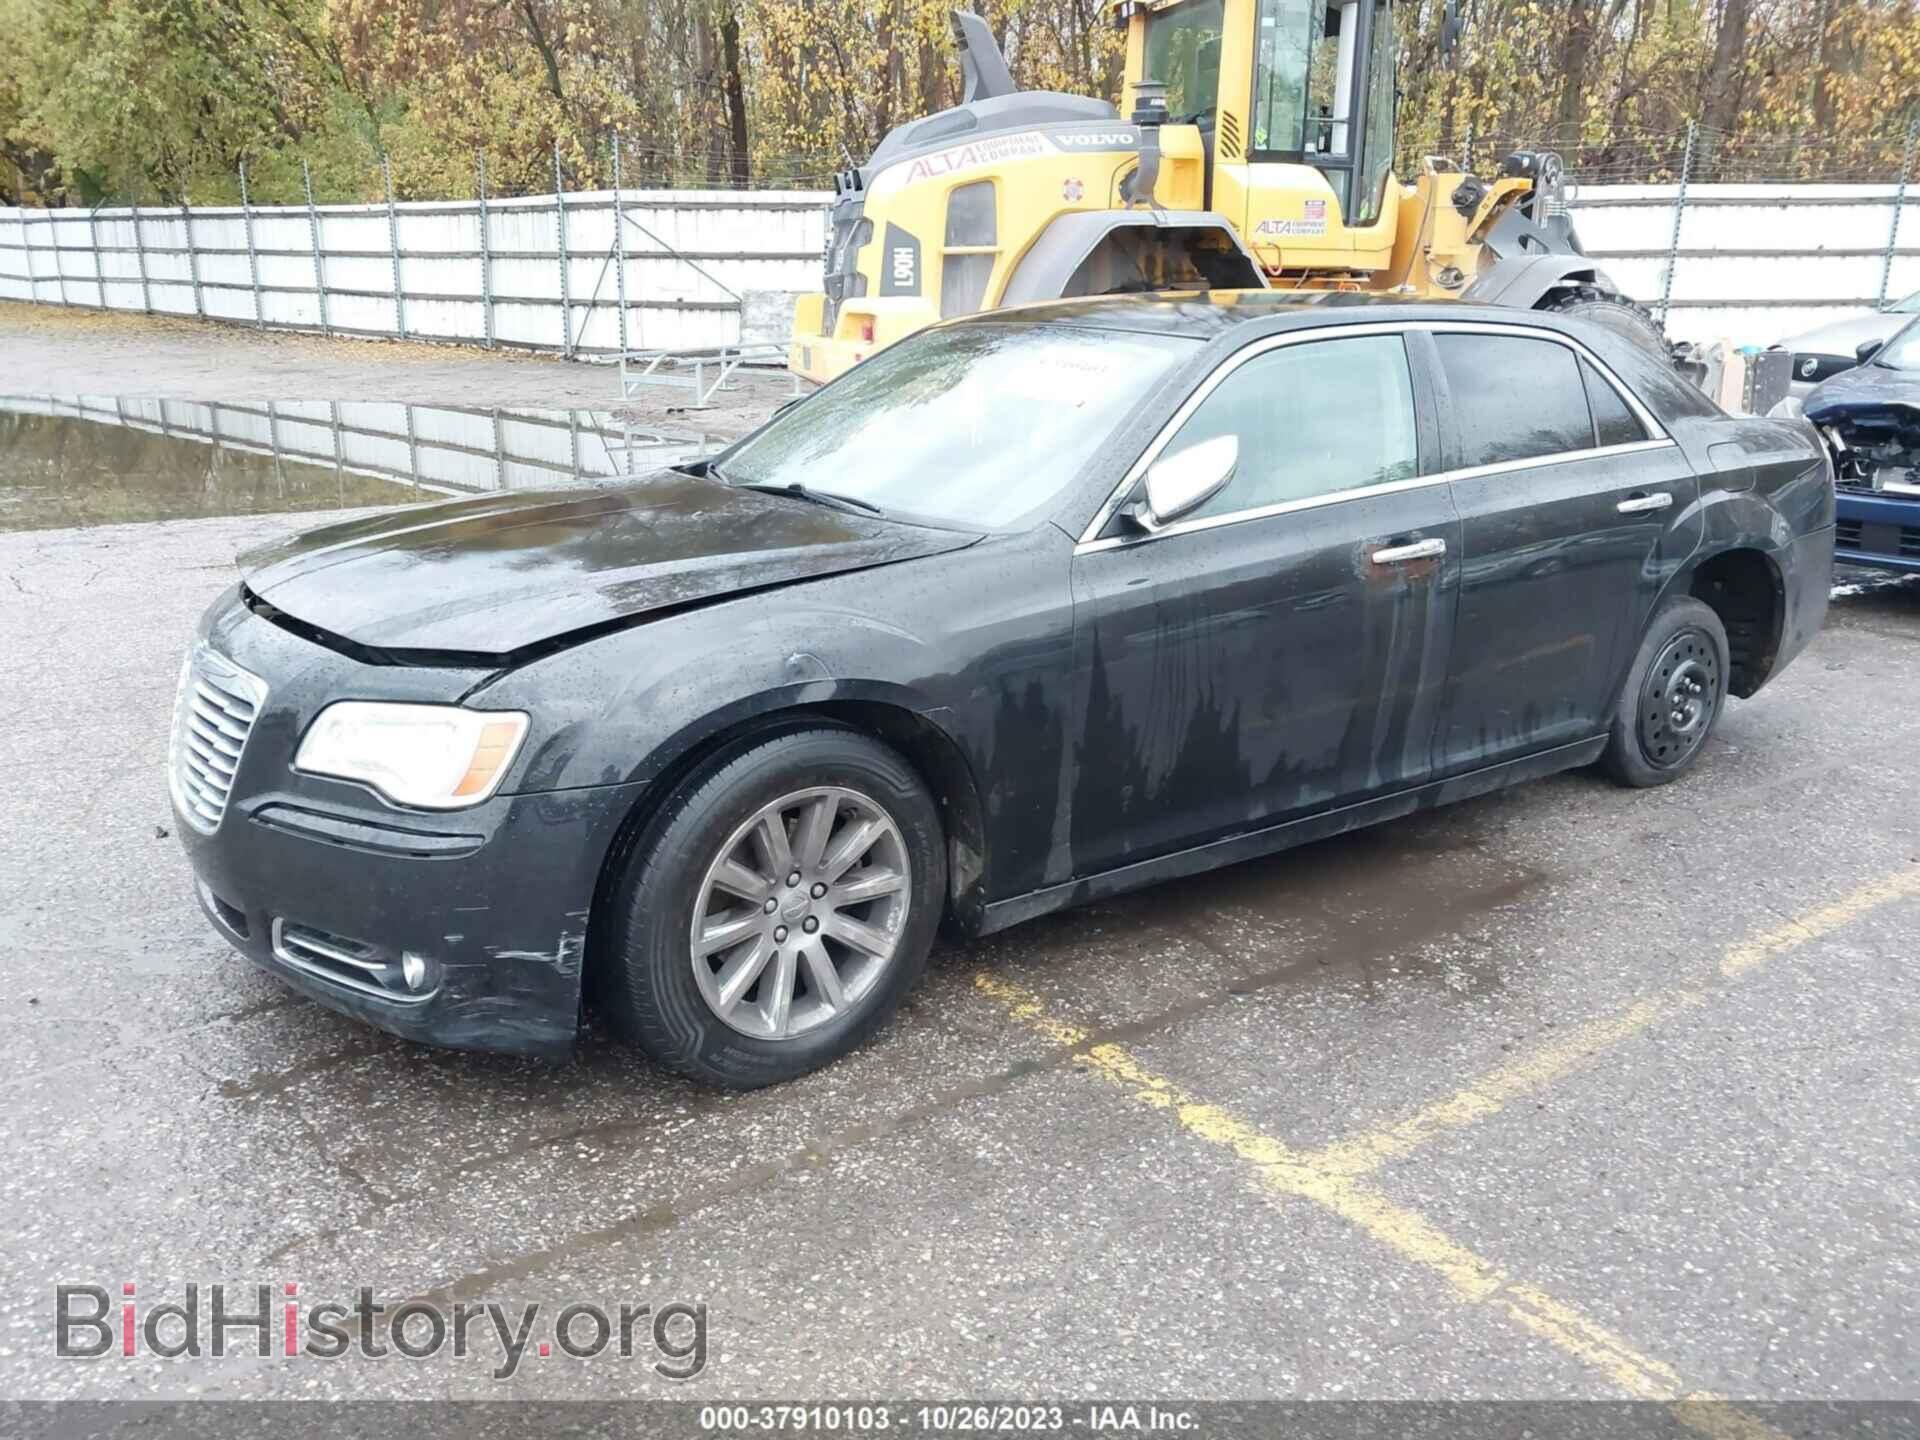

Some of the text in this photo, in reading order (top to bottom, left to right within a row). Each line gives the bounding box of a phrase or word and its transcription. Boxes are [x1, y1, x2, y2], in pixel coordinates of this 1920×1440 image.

[975, 135, 1041, 152] EQUIPMENT
[1055, 134, 1134, 145] VOLVO
[979, 145, 1044, 163] COMPANY
[906, 146, 977, 185] ALTA
[1256, 221, 1292, 234] ALTA
[894, 247, 914, 286] L90H
